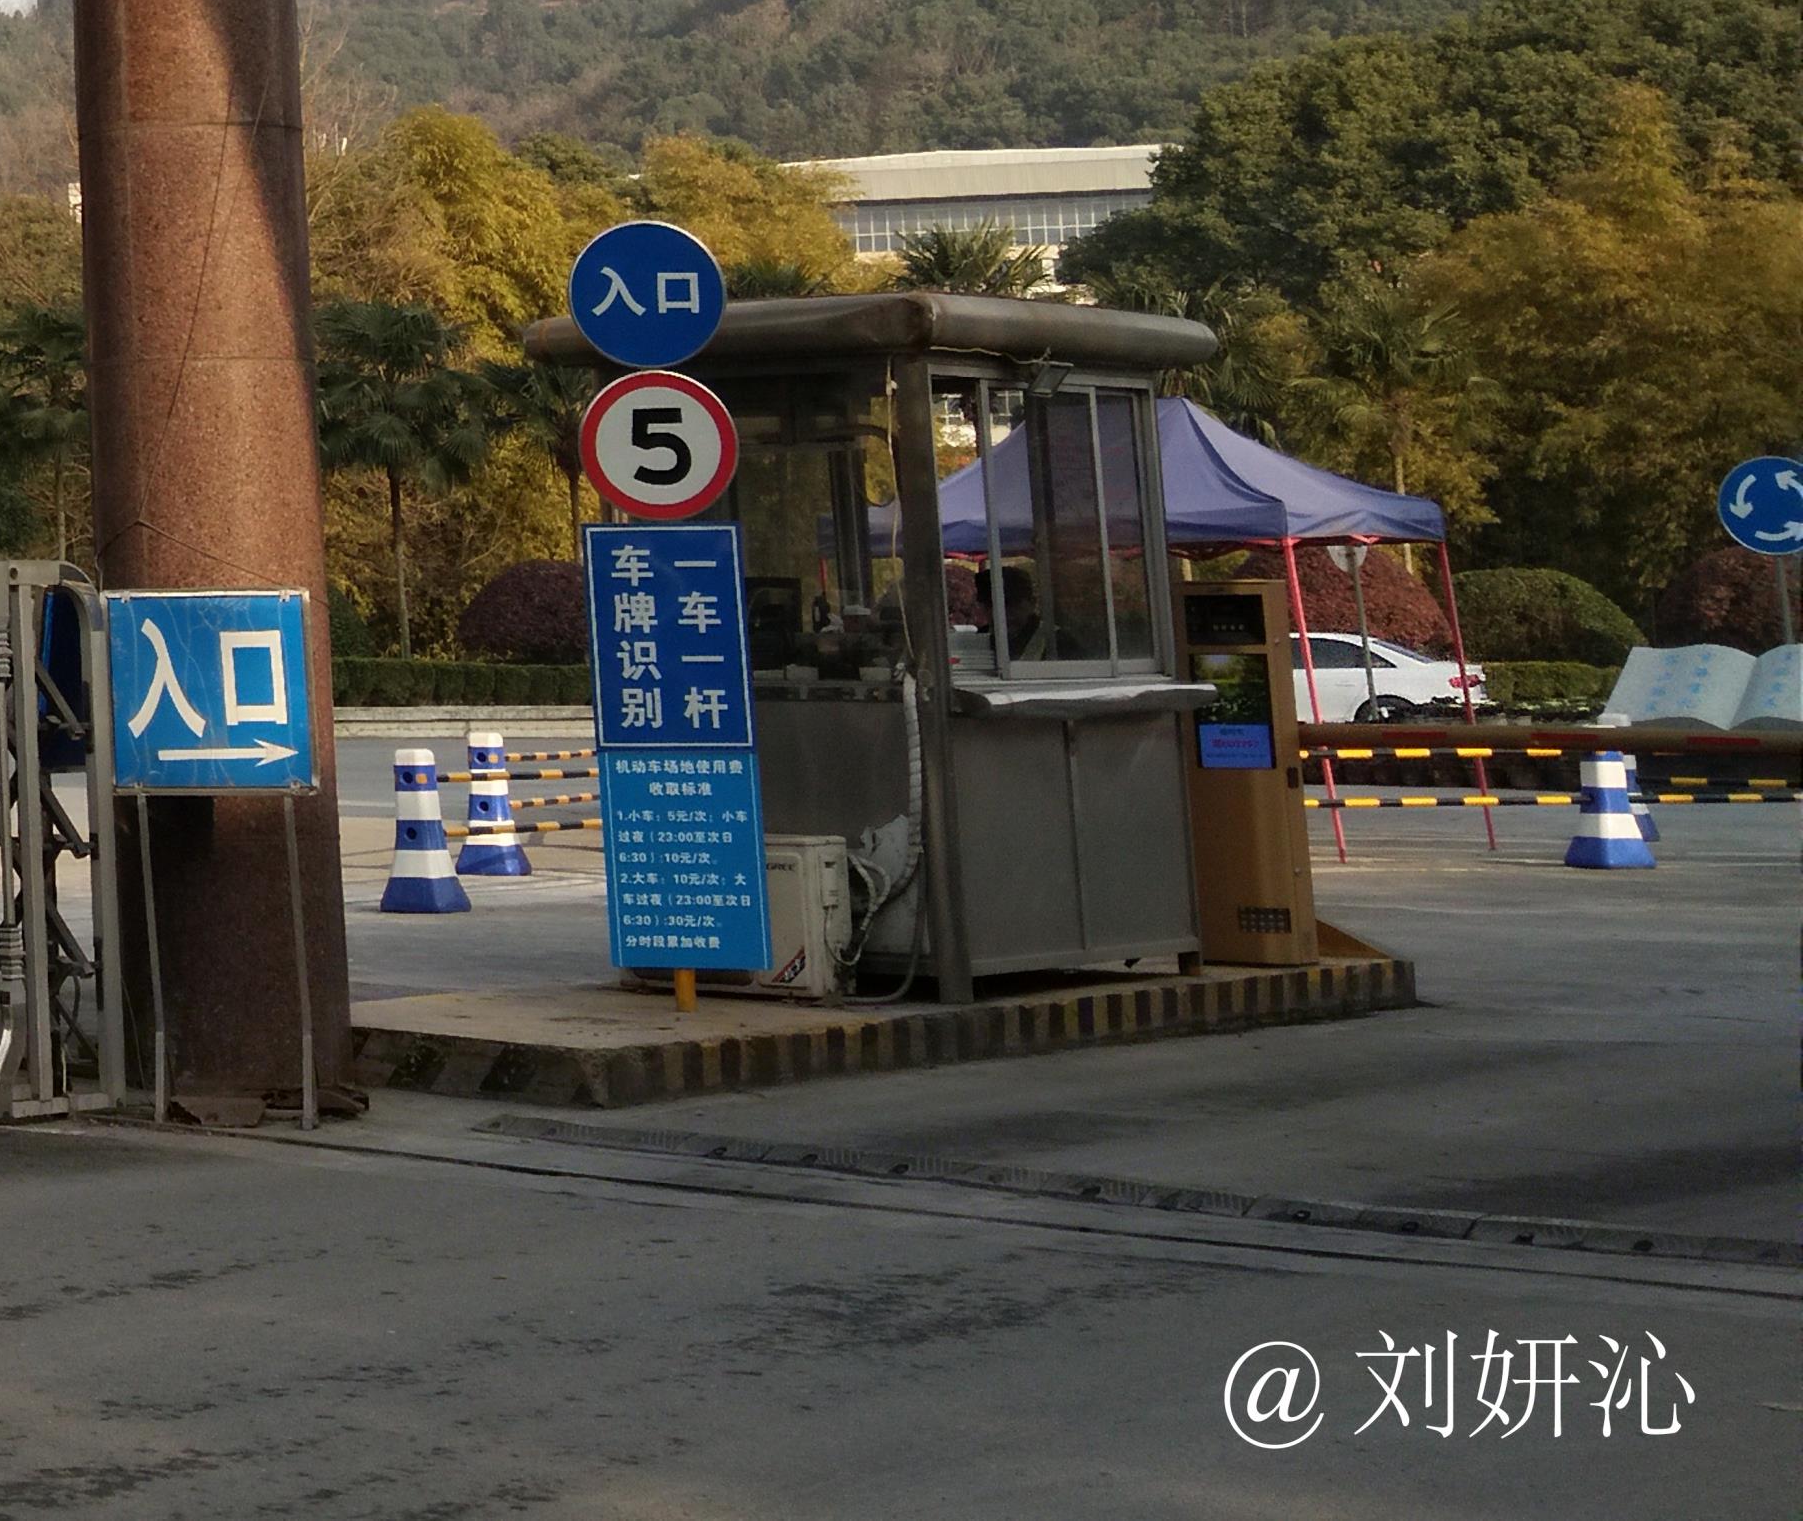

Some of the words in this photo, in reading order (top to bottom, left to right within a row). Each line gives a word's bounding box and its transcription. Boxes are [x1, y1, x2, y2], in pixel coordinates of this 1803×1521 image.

[591, 266, 701, 317] 入口
[631, 407, 692, 486] 5
[611, 545, 663, 729] 车牌识别
[674, 560, 729, 729] 一车一杆
[127, 617, 289, 739] 入口
[615, 759, 744, 775] 机动车场地使用费
[649, 782, 713, 797] 收取标准
